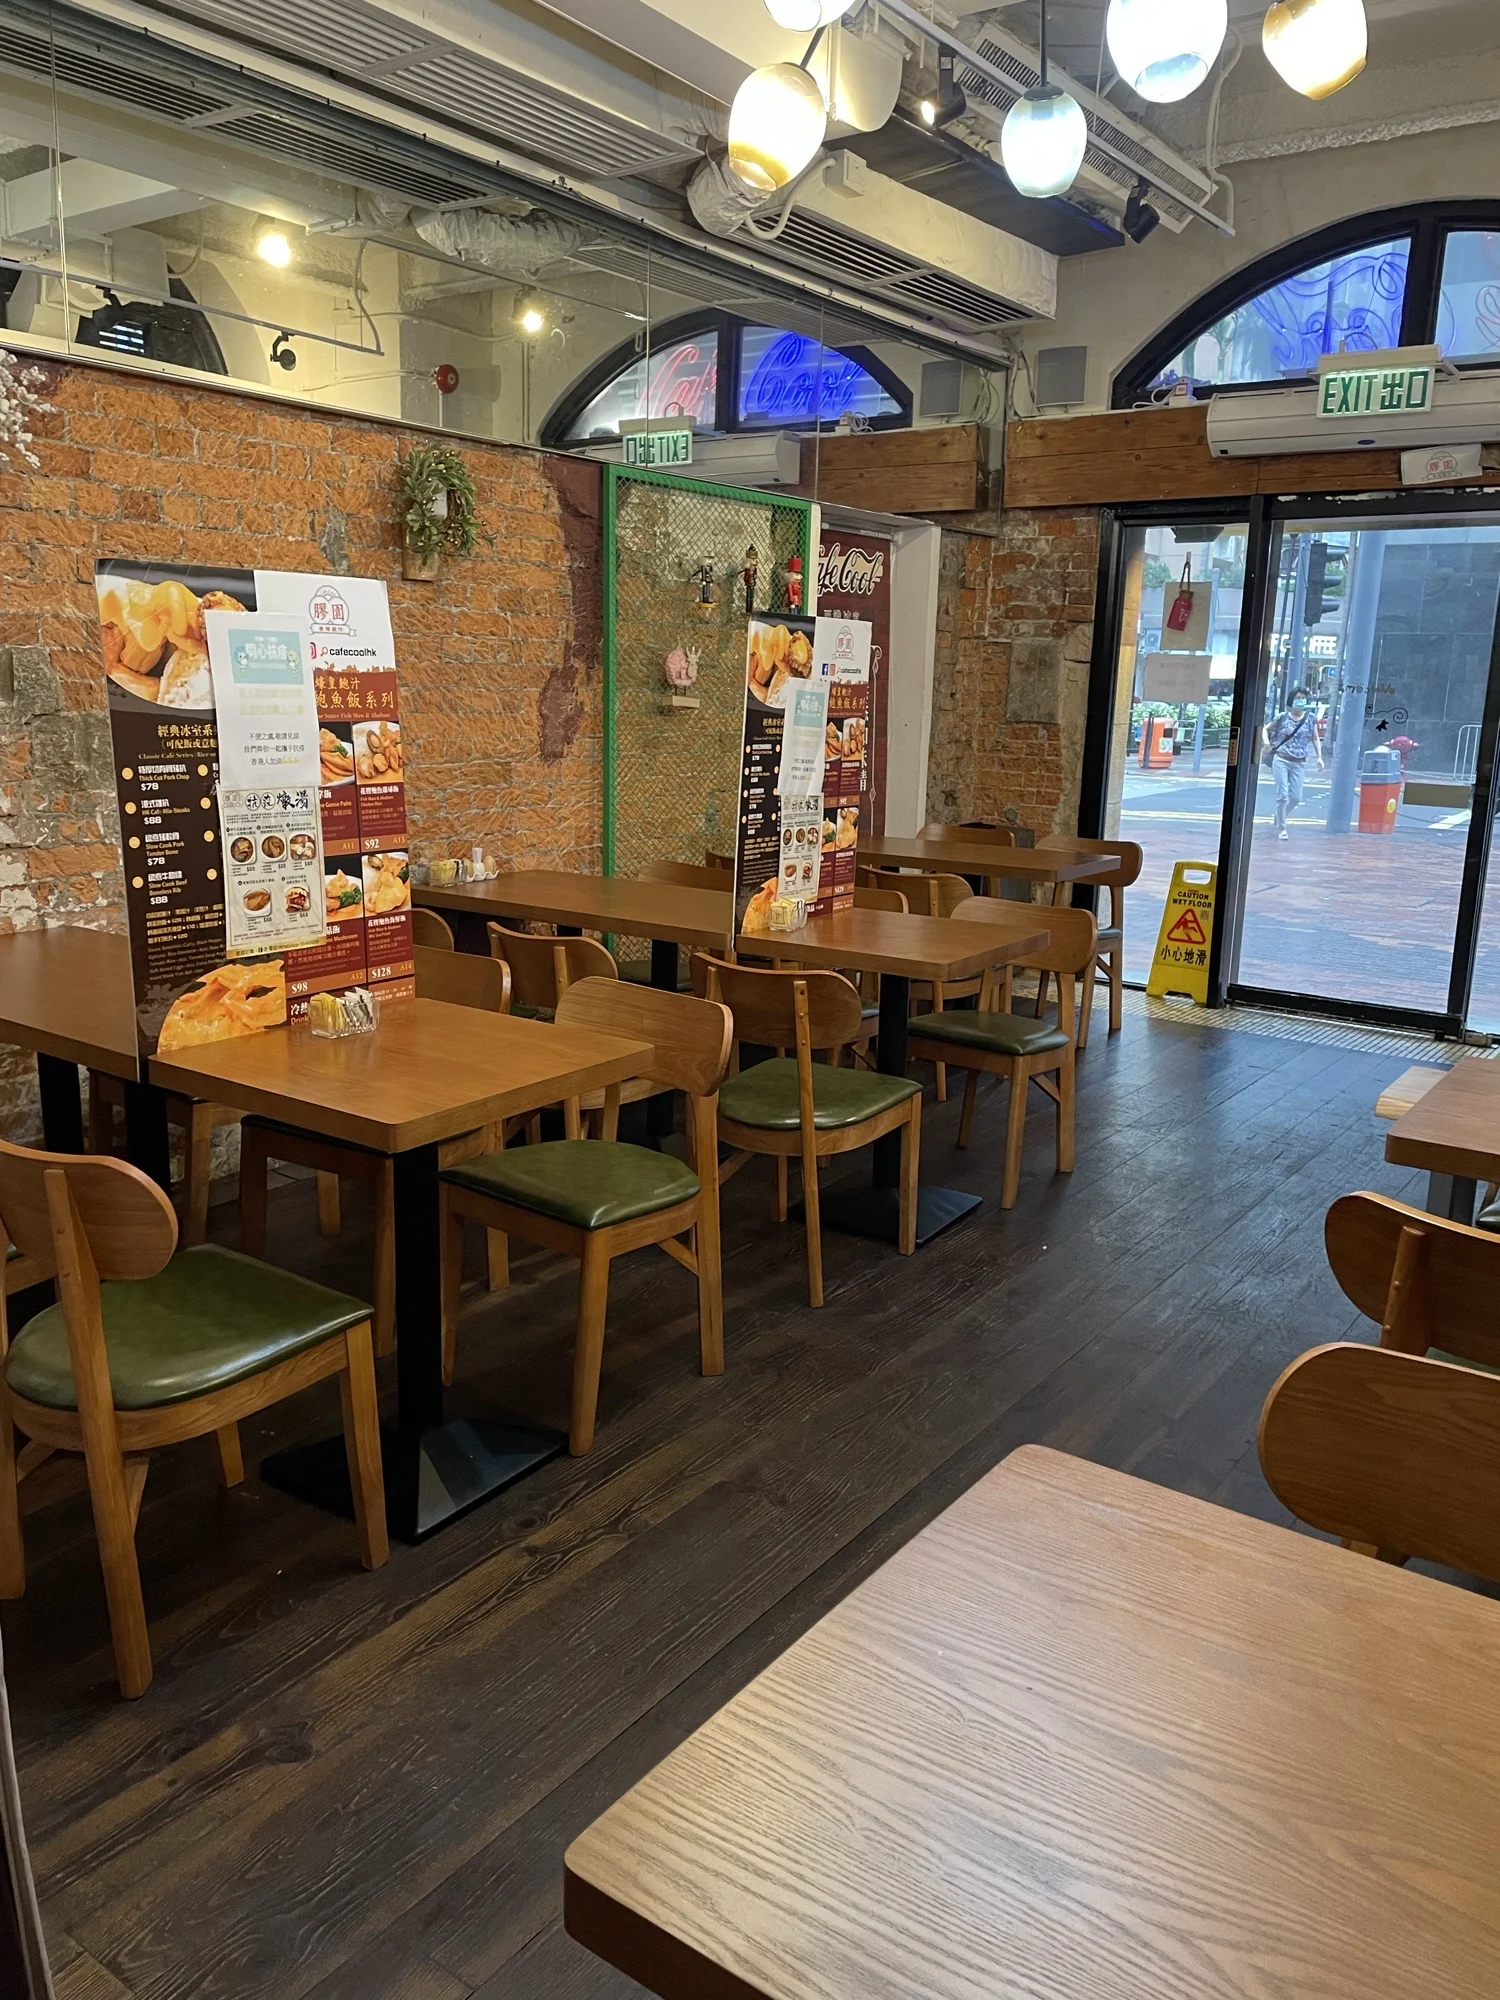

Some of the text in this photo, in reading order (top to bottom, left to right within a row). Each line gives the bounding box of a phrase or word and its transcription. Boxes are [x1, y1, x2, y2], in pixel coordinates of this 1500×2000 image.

[745, 331, 862, 415] Cool
[1322, 370, 1430, 414] EXIT 出口
[839, 547, 884, 595] Cool
[329, 647, 377, 657] cafecoolhk
[157, 724, 217, 737] 經典冰室系
[141, 782, 159, 791] $78
[144, 816, 162, 825] $88
[365, 839, 379, 849] $92
[147, 857, 165, 866] $78
[150, 896, 168, 905] $88
[1177, 891, 1209, 900] CAUTION
[1188, 899, 1212, 908] FLOOR
[1160, 944, 1207, 967] 小心地滑
[371, 966, 391, 979] $128
[400, 963, 412, 971] A14
[291, 972, 364, 994] $98 A12
